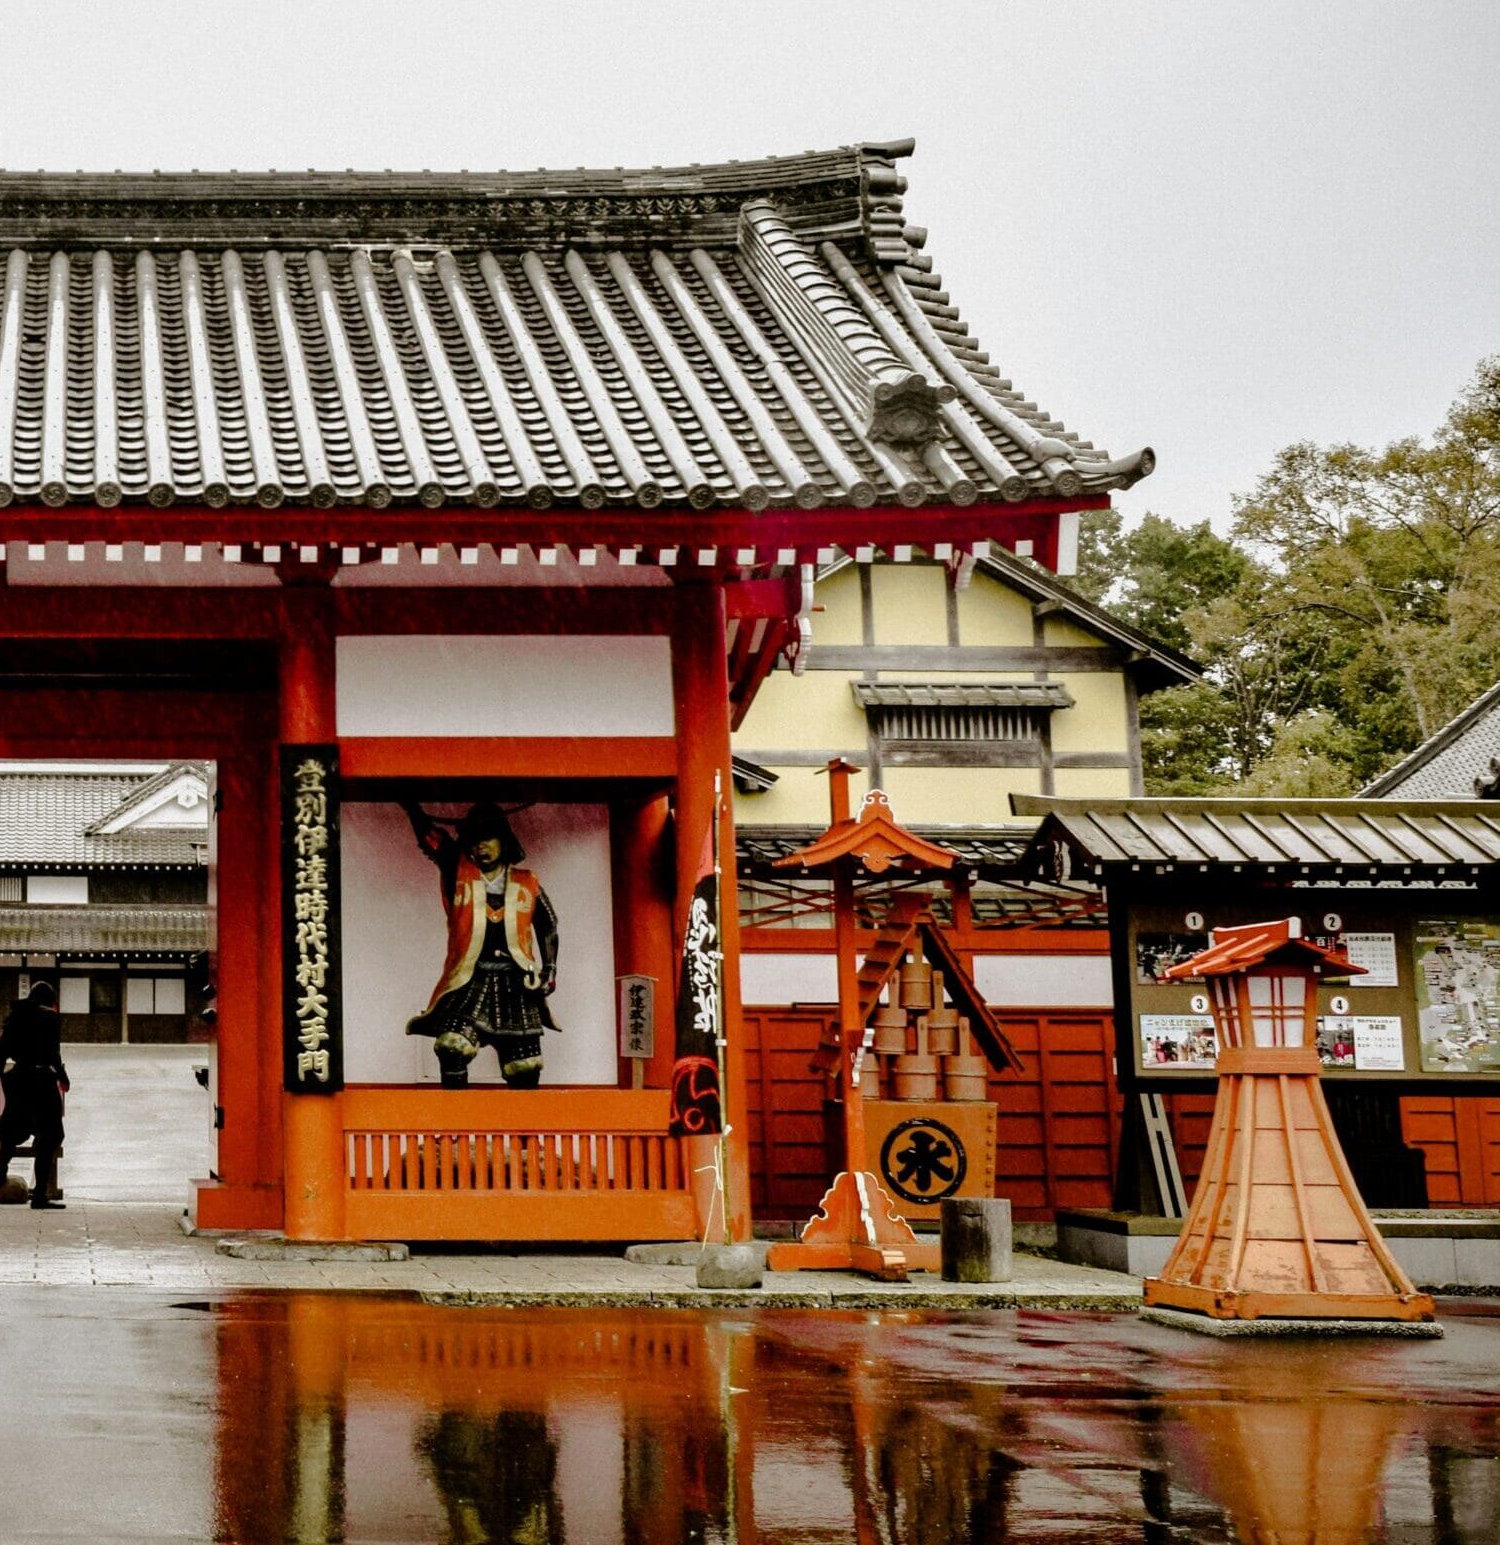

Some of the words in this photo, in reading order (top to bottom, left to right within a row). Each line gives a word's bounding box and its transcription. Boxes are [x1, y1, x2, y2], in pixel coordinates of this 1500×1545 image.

[294, 758, 331, 1083] 登別伊達時代村大手門
[1191, 915, 1198, 927] 1
[1328, 916, 1336, 928] 2
[1196, 998, 1203, 1010] 3
[1336, 999, 1343, 1010] 4
